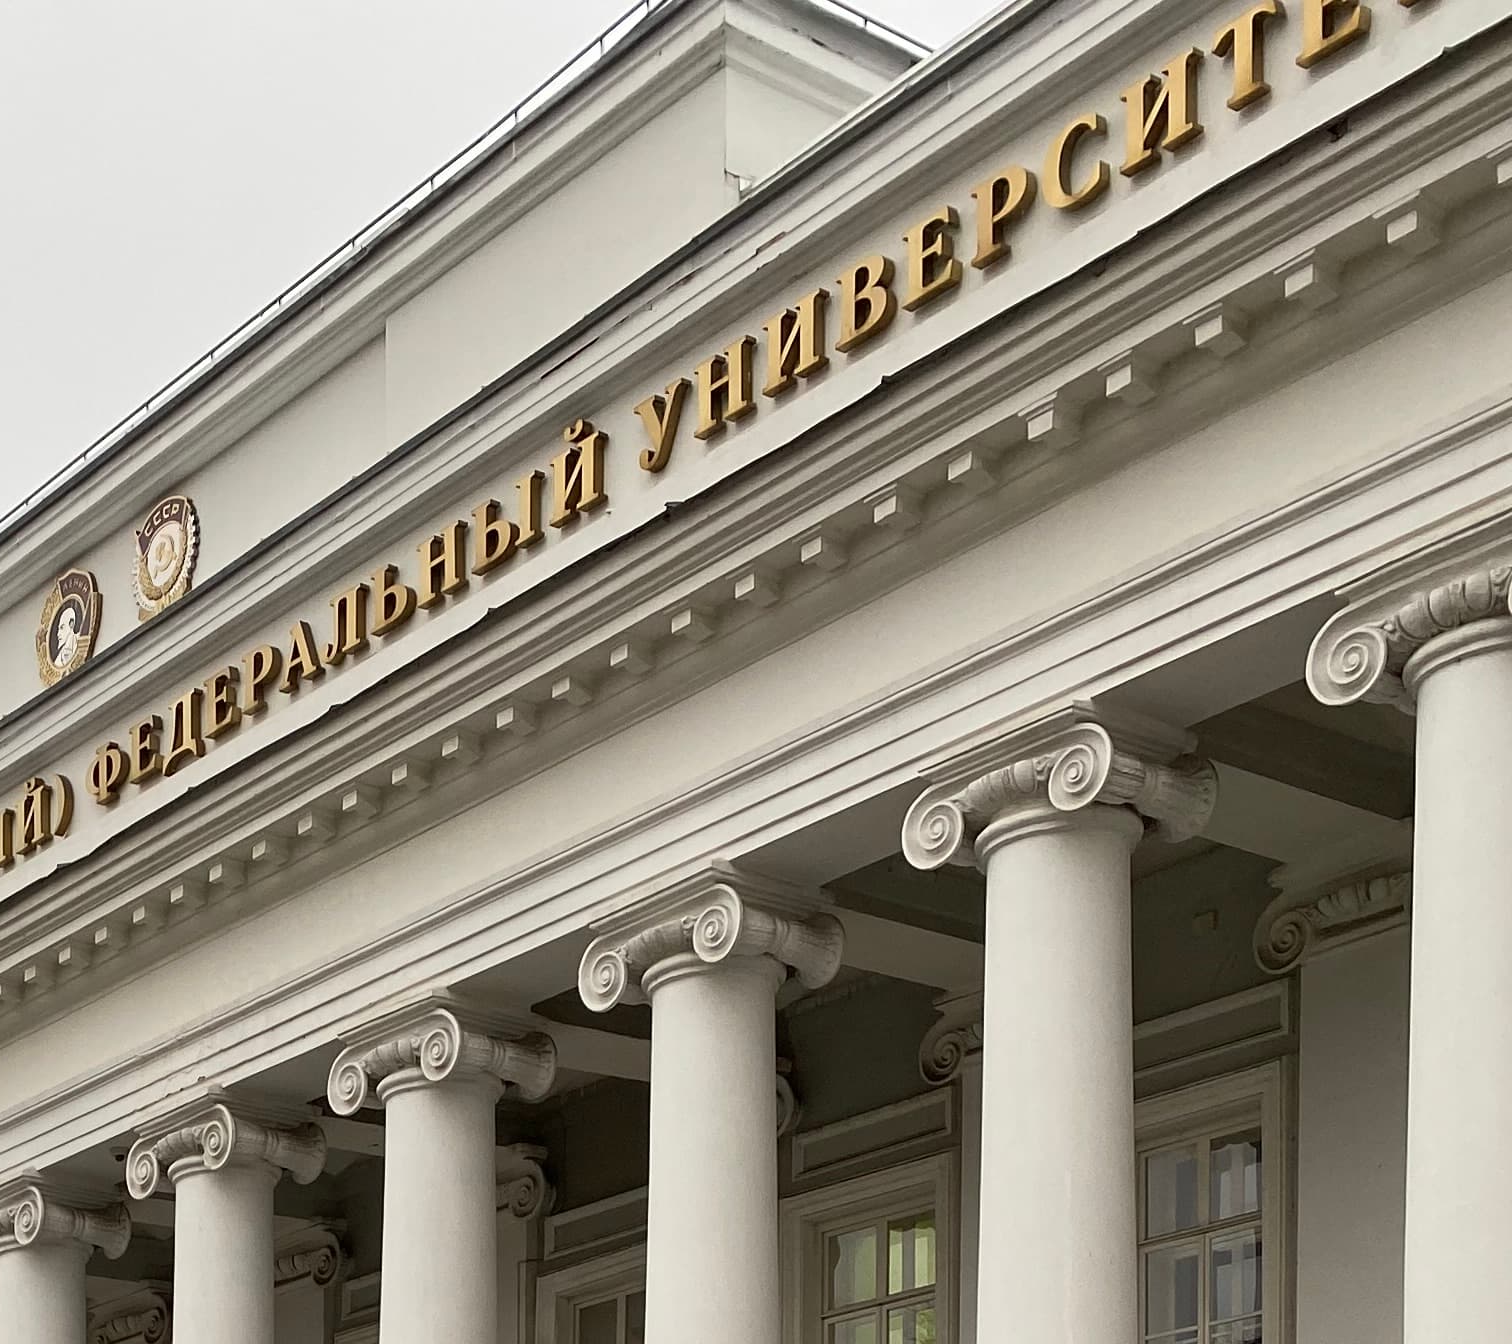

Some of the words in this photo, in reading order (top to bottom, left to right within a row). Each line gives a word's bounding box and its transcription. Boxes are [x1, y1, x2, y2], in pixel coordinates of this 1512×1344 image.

[86, 418, 609, 805] ФЕДЕРАЛЬНЫЙ
[634, 0, 1413, 473] УНИВЕРСИТЕ
[144, 503, 180, 537] СССР
